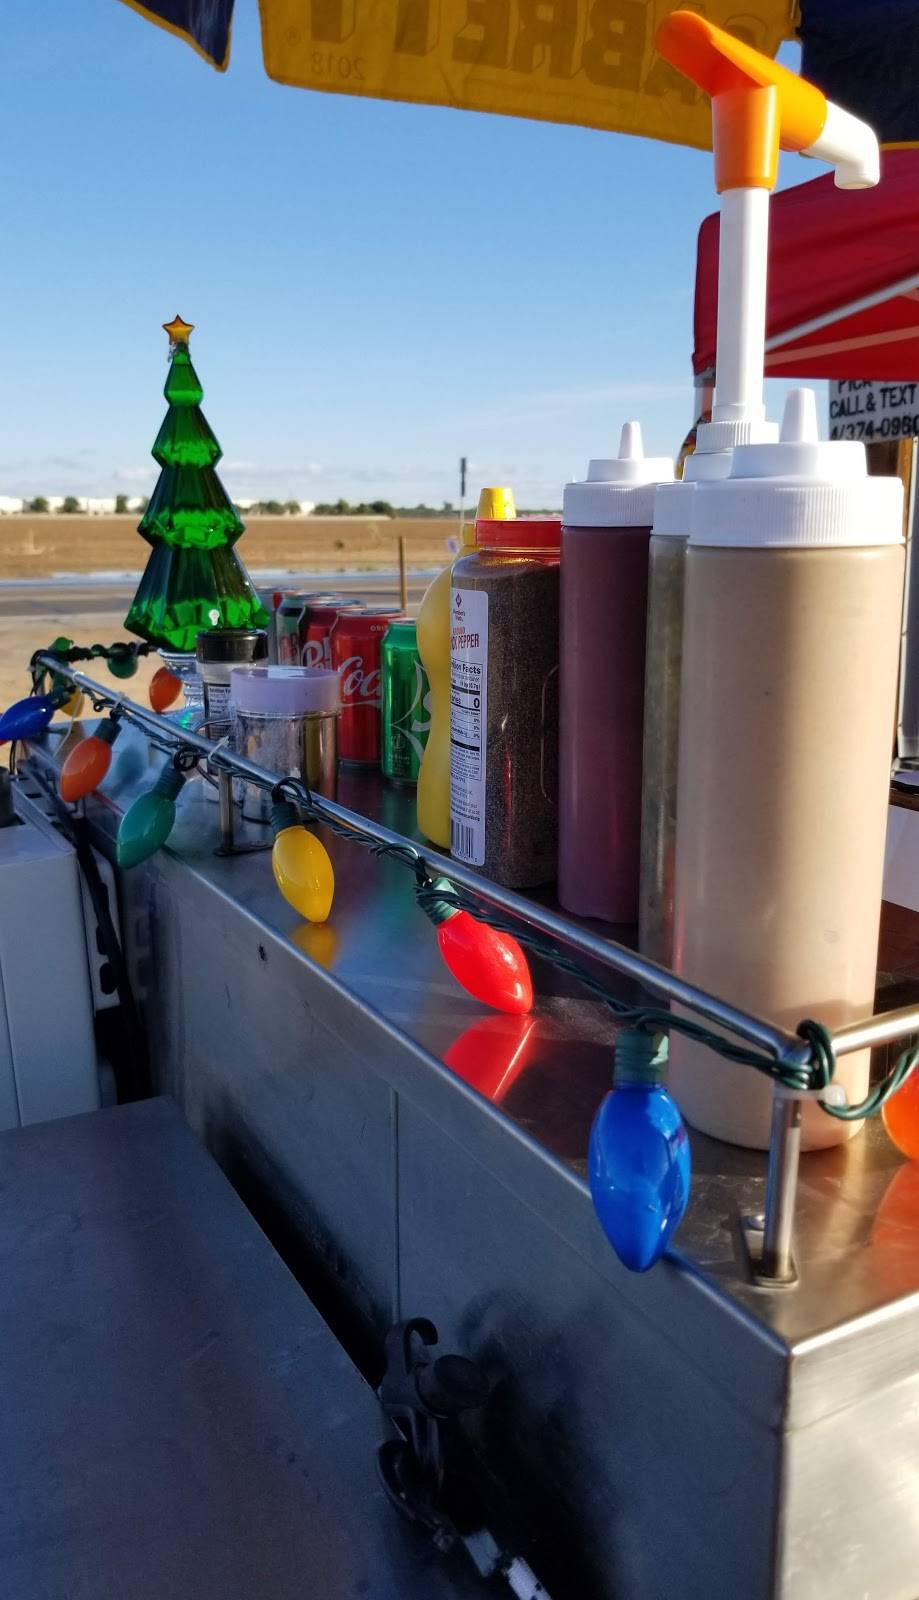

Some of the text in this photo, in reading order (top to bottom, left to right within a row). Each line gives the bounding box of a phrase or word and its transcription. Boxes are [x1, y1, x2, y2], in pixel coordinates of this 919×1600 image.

[830, 384, 917, 419] CALL & TEXT
[458, 633, 480, 650] PEPPER
[463, 663, 481, 674] Facts
